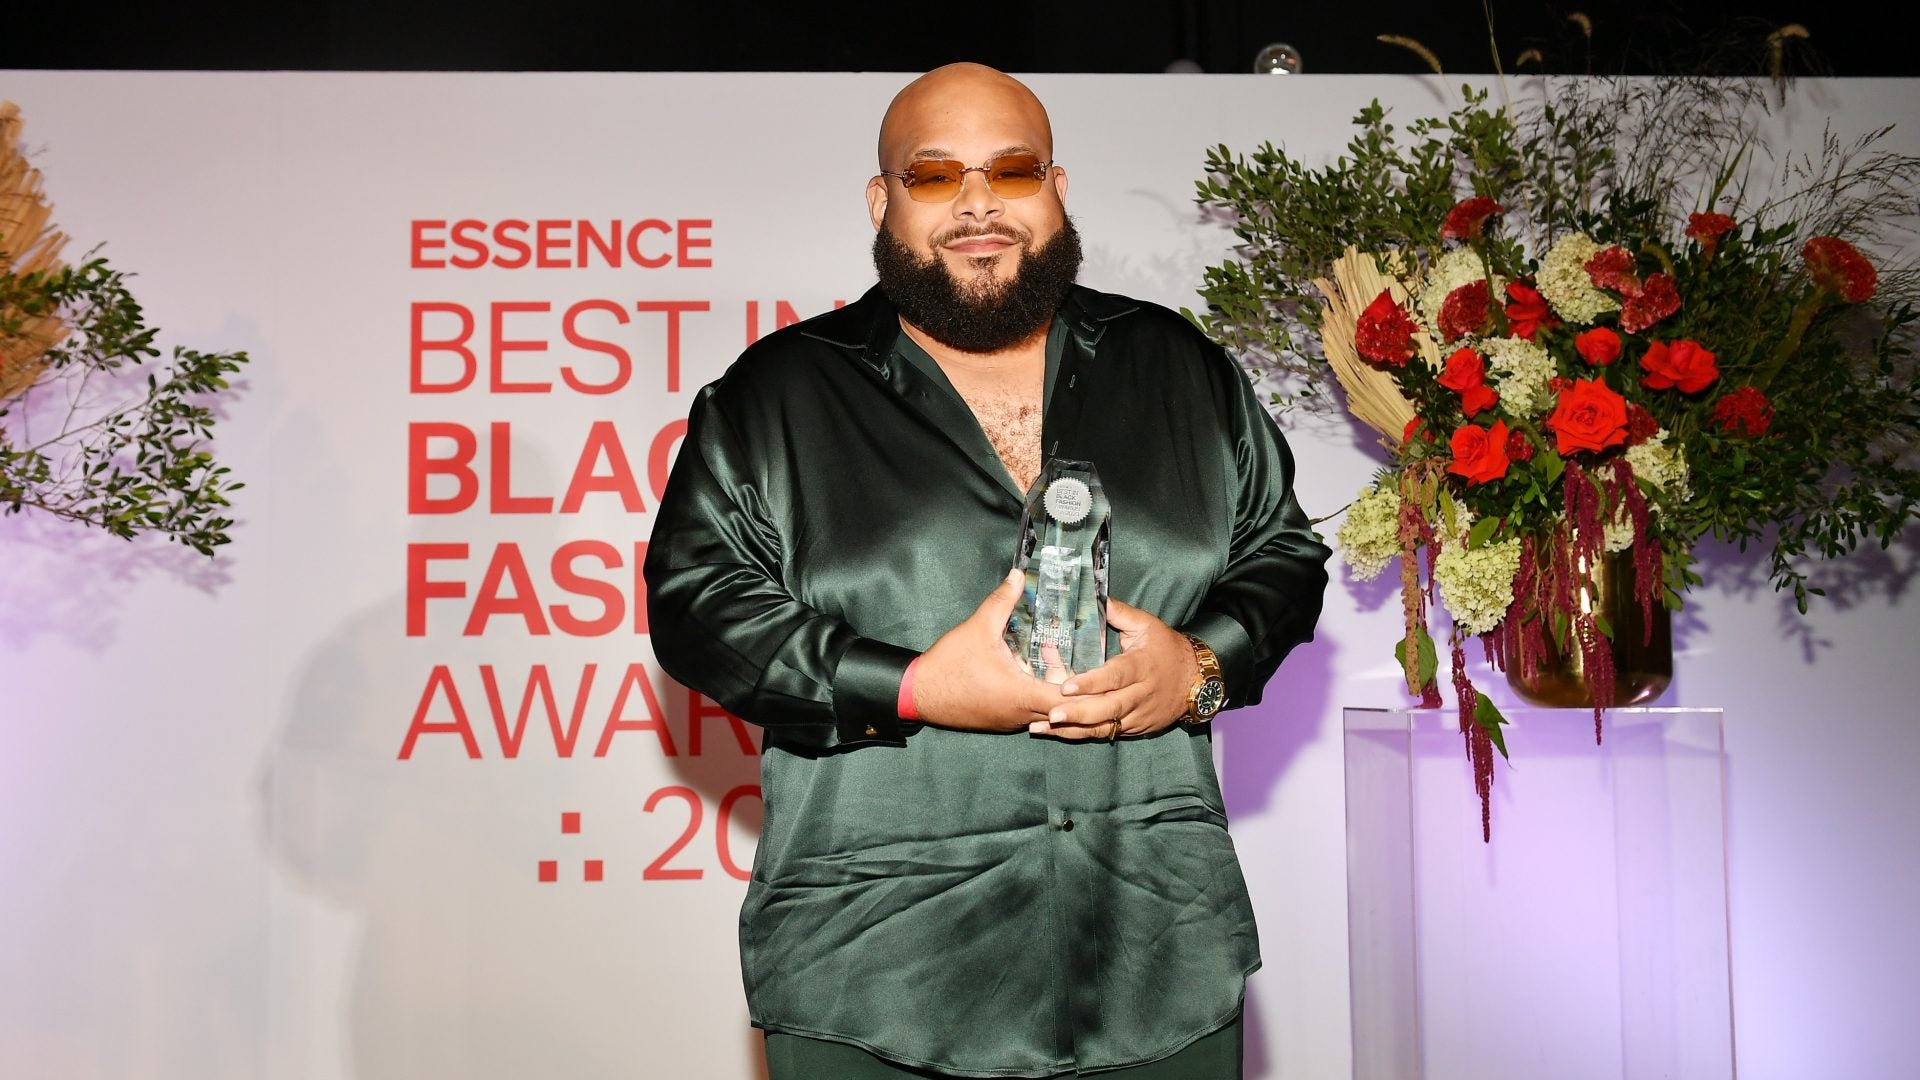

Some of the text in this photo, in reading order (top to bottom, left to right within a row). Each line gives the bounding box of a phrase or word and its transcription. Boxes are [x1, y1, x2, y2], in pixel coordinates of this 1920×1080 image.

[410, 218, 713, 269] ESSENCE
[409, 299, 846, 395] BEST I
[406, 540, 650, 637] FAS
[1031, 630, 1072, 647] Hudson
